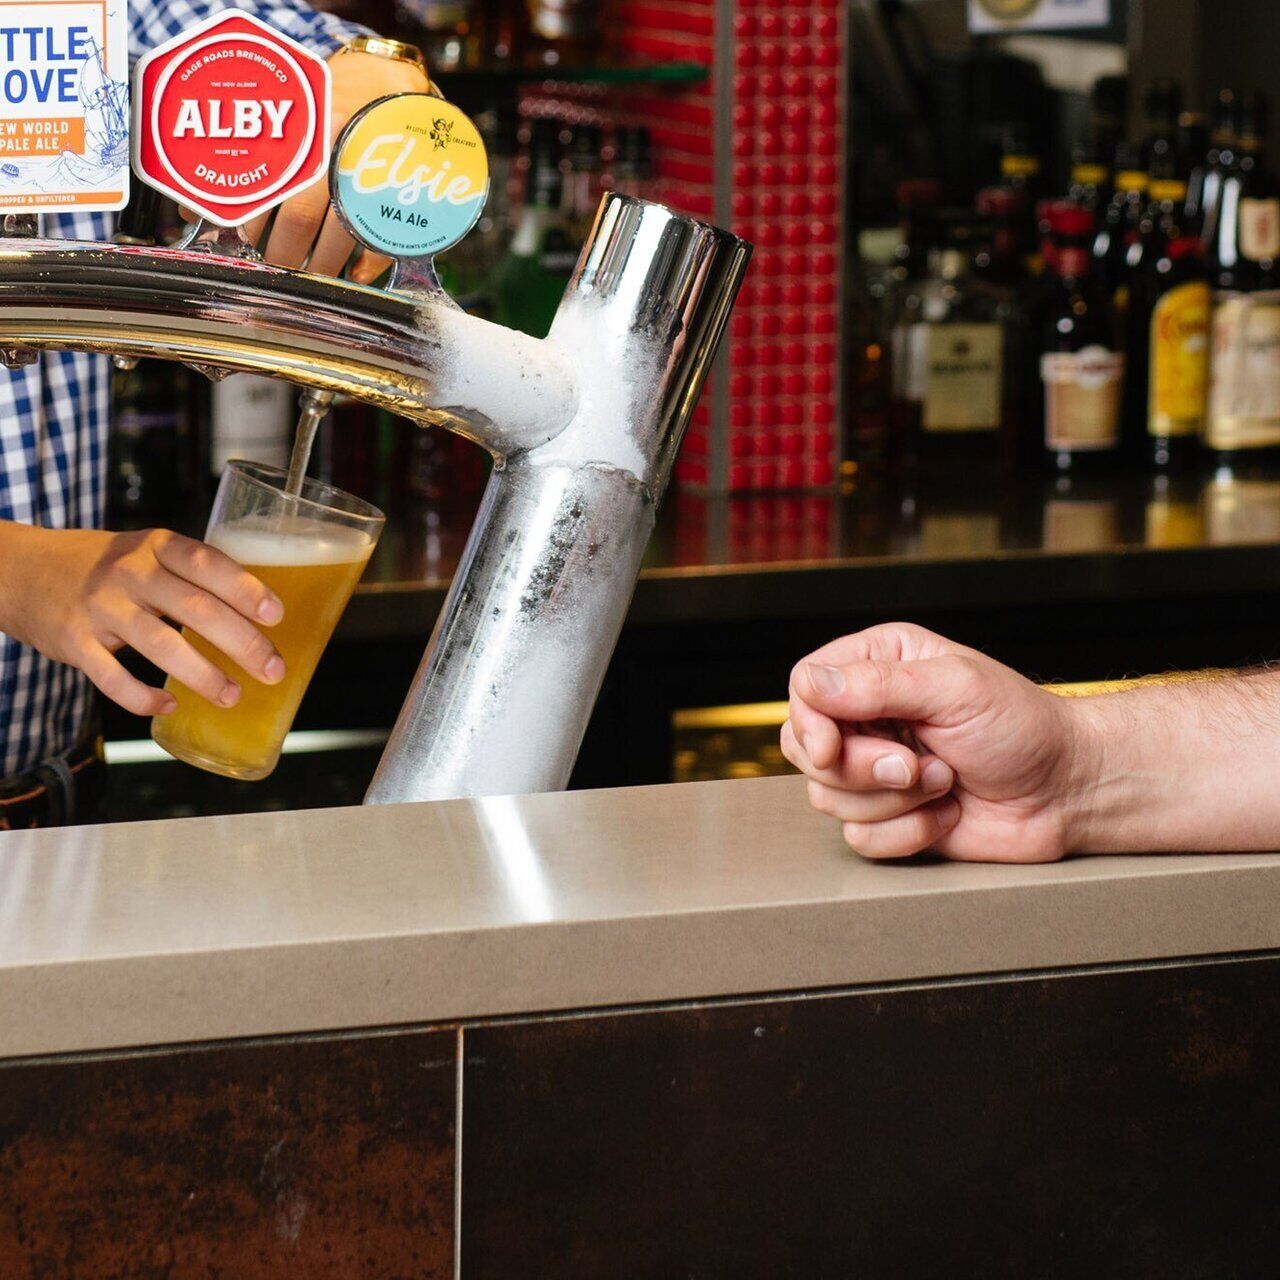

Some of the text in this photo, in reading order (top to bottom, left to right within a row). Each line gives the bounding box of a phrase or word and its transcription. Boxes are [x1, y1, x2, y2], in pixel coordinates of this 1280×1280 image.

[181, 49, 288, 83] GAGE ROADS BREWING CO
[23, 120, 69, 135] WORLD
[172, 99, 293, 139] ALBY
[35, 136, 60, 150] ALE
[194, 163, 270, 188] DRAUGHT
[348, 134, 483, 205] Elsie
[381, 205, 428, 228] WA Ale
